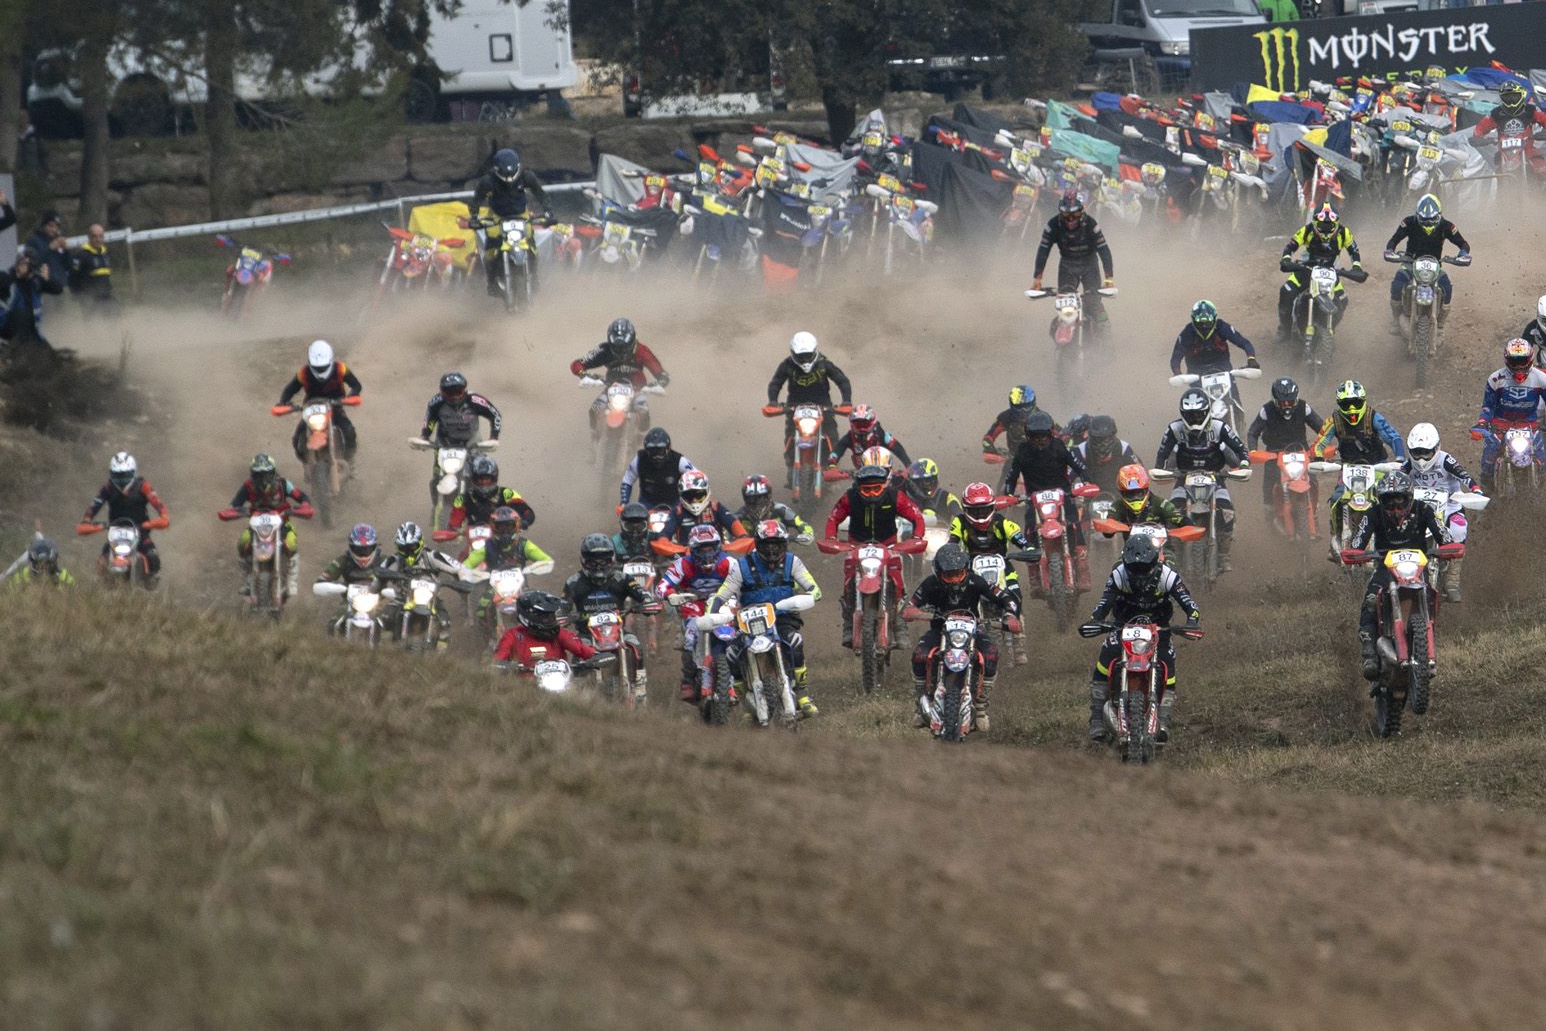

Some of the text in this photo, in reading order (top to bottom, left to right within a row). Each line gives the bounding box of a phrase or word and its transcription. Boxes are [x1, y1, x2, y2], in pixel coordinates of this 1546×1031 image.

[1307, 22, 1495, 69] MONSTER
[1421, 261, 1432, 270] 36
[1320, 270, 1331, 278] 90
[1059, 299, 1073, 307] 112
[1291, 454, 1297, 462] 3
[1424, 491, 1438, 500] 27
[864, 548, 878, 558] 72
[1399, 553, 1412, 562] 87
[979, 559, 998, 567] 114
[631, 566, 648, 574] 113
[597, 614, 610, 624] 82
[743, 609, 764, 620] 144
[954, 622, 967, 630] 15
[1133, 629, 1141, 638] 8
[544, 663, 559, 672] 25
